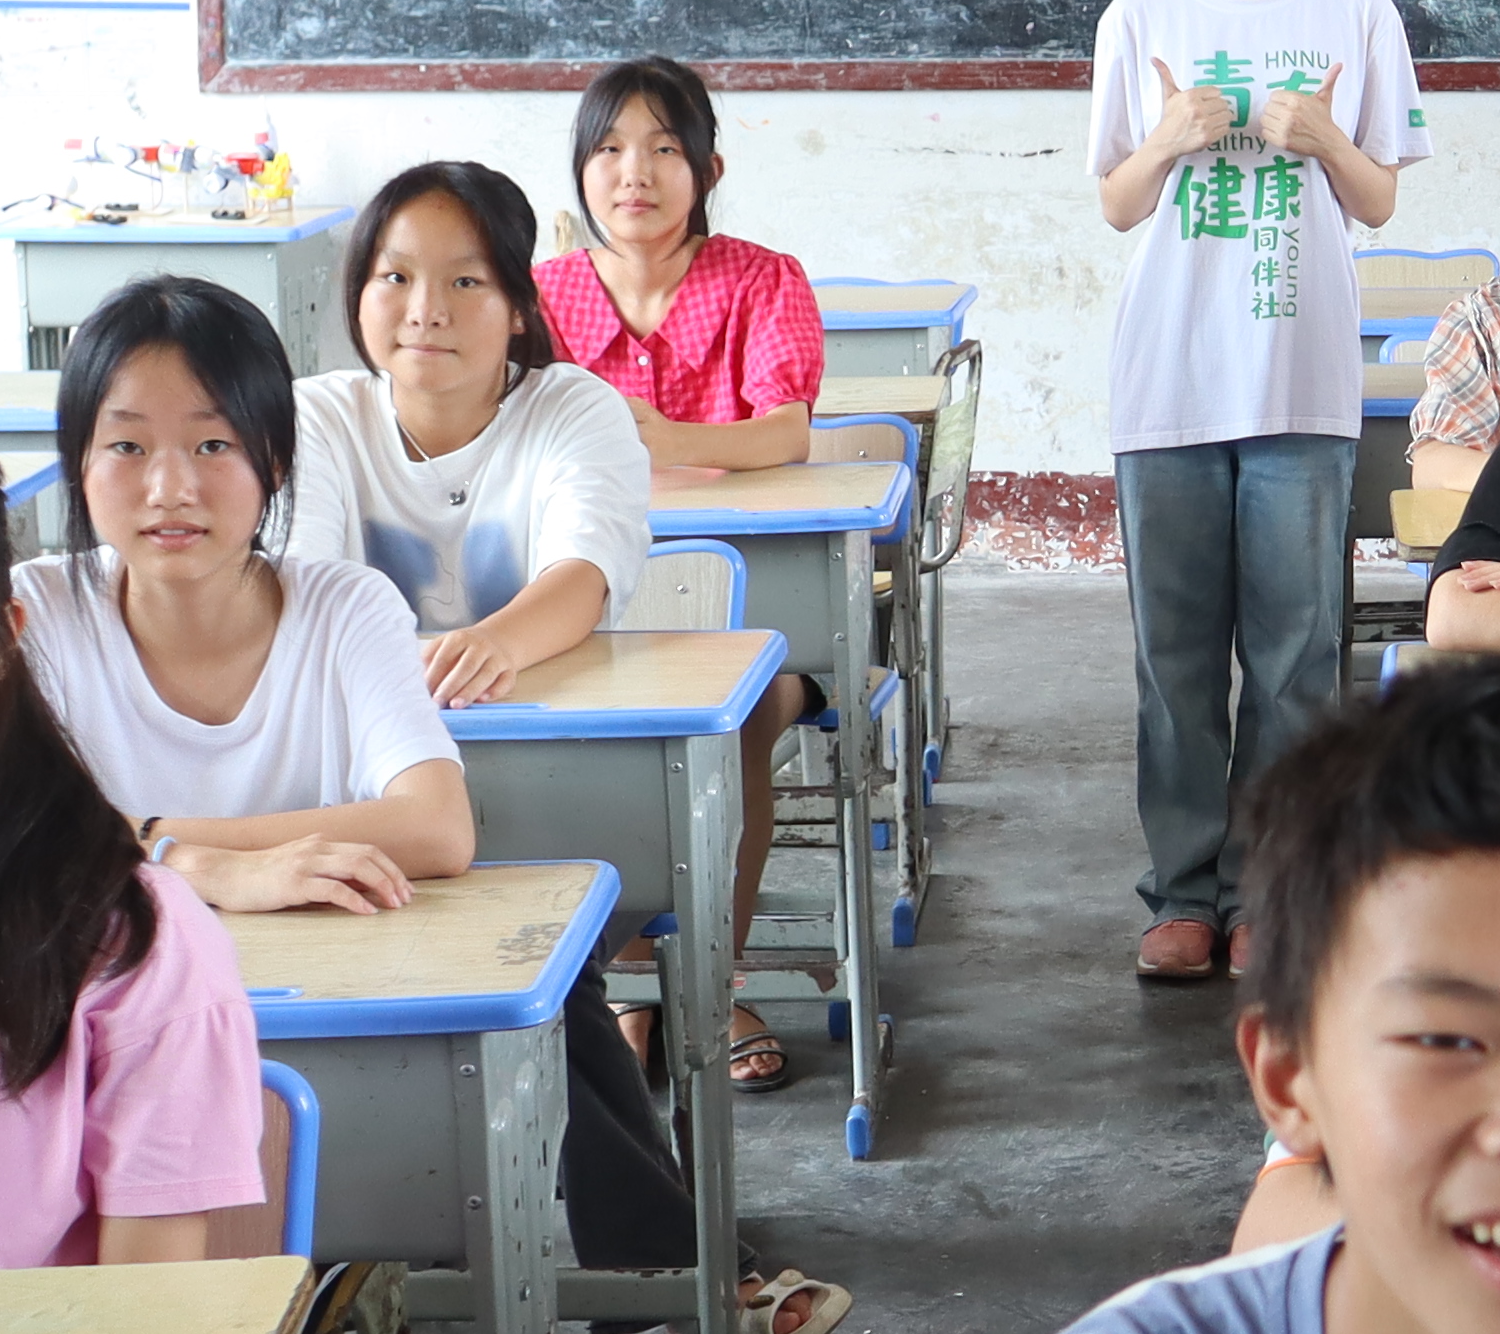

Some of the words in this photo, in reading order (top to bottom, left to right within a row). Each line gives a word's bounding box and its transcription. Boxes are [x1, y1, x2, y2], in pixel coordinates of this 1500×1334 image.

[1265, 49, 1330, 70] HNNU
[1173, 154, 1304, 241] 健康
[1251, 226, 1282, 320] 同伴社
[1281, 227, 1300, 318] young
